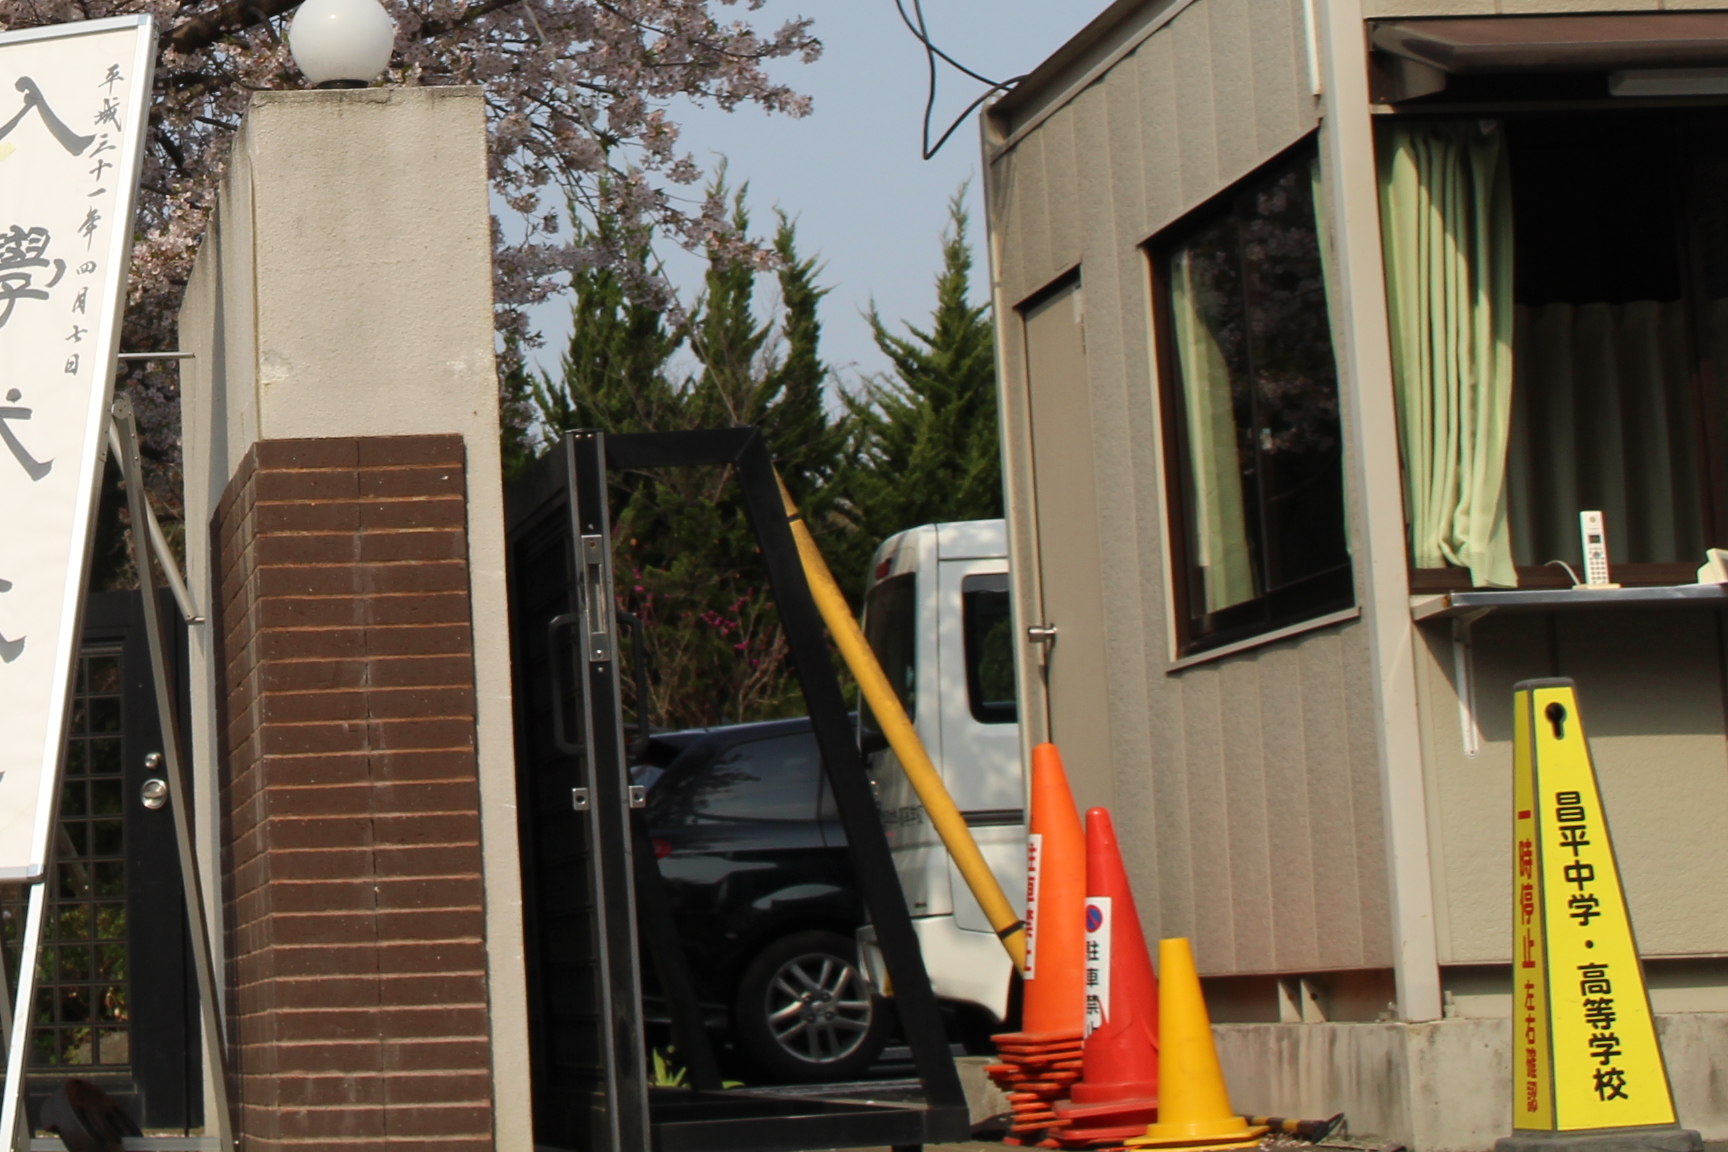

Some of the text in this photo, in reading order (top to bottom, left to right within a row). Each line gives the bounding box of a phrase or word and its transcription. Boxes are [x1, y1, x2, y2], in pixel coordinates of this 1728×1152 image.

[1517, 809, 1536, 968] 一時停止
[1554, 791, 1629, 1102] 昌平中学・高等学校
